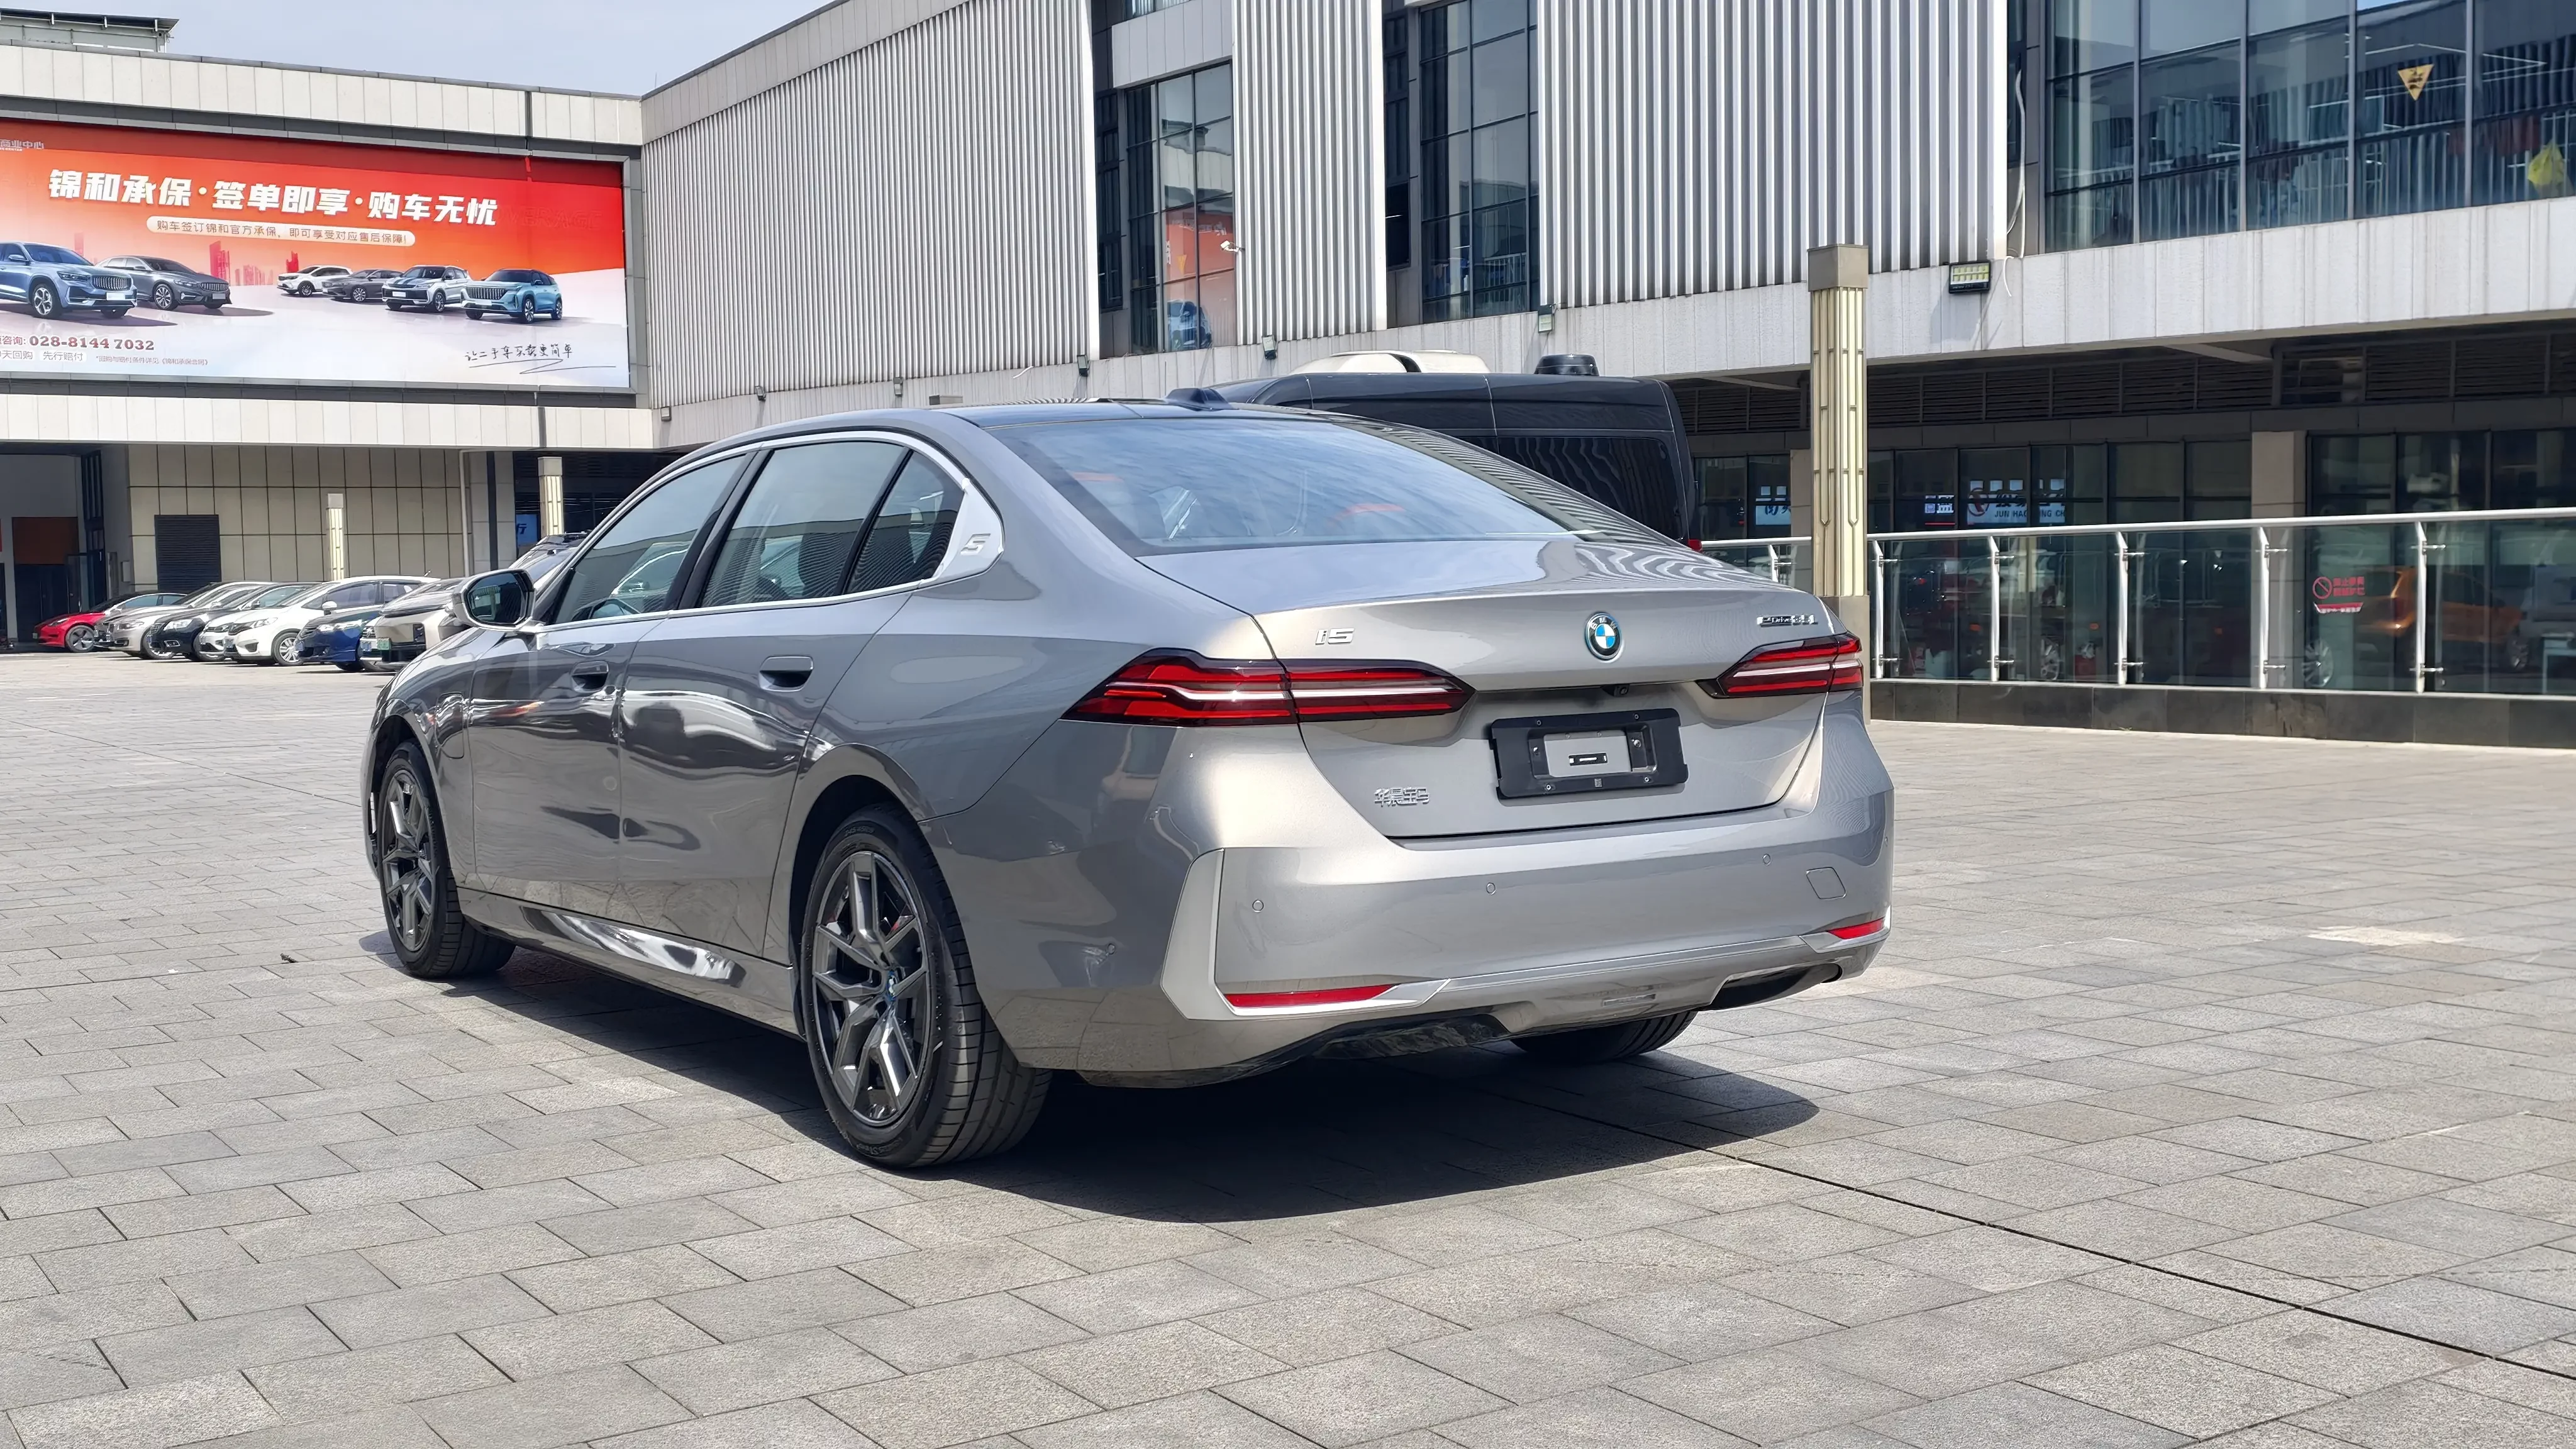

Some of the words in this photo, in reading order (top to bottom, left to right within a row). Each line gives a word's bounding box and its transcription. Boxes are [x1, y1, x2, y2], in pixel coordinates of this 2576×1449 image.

[48, 169, 498, 226] 锦和承保·签单即享·购车无忧
[0, 335, 26, 345] 咨询:
[114, 339, 155, 350] 7032
[0, 350, 33, 360] 天回购
[43, 351, 83, 361] 先行赔付
[1315, 628, 1355, 645] i5
